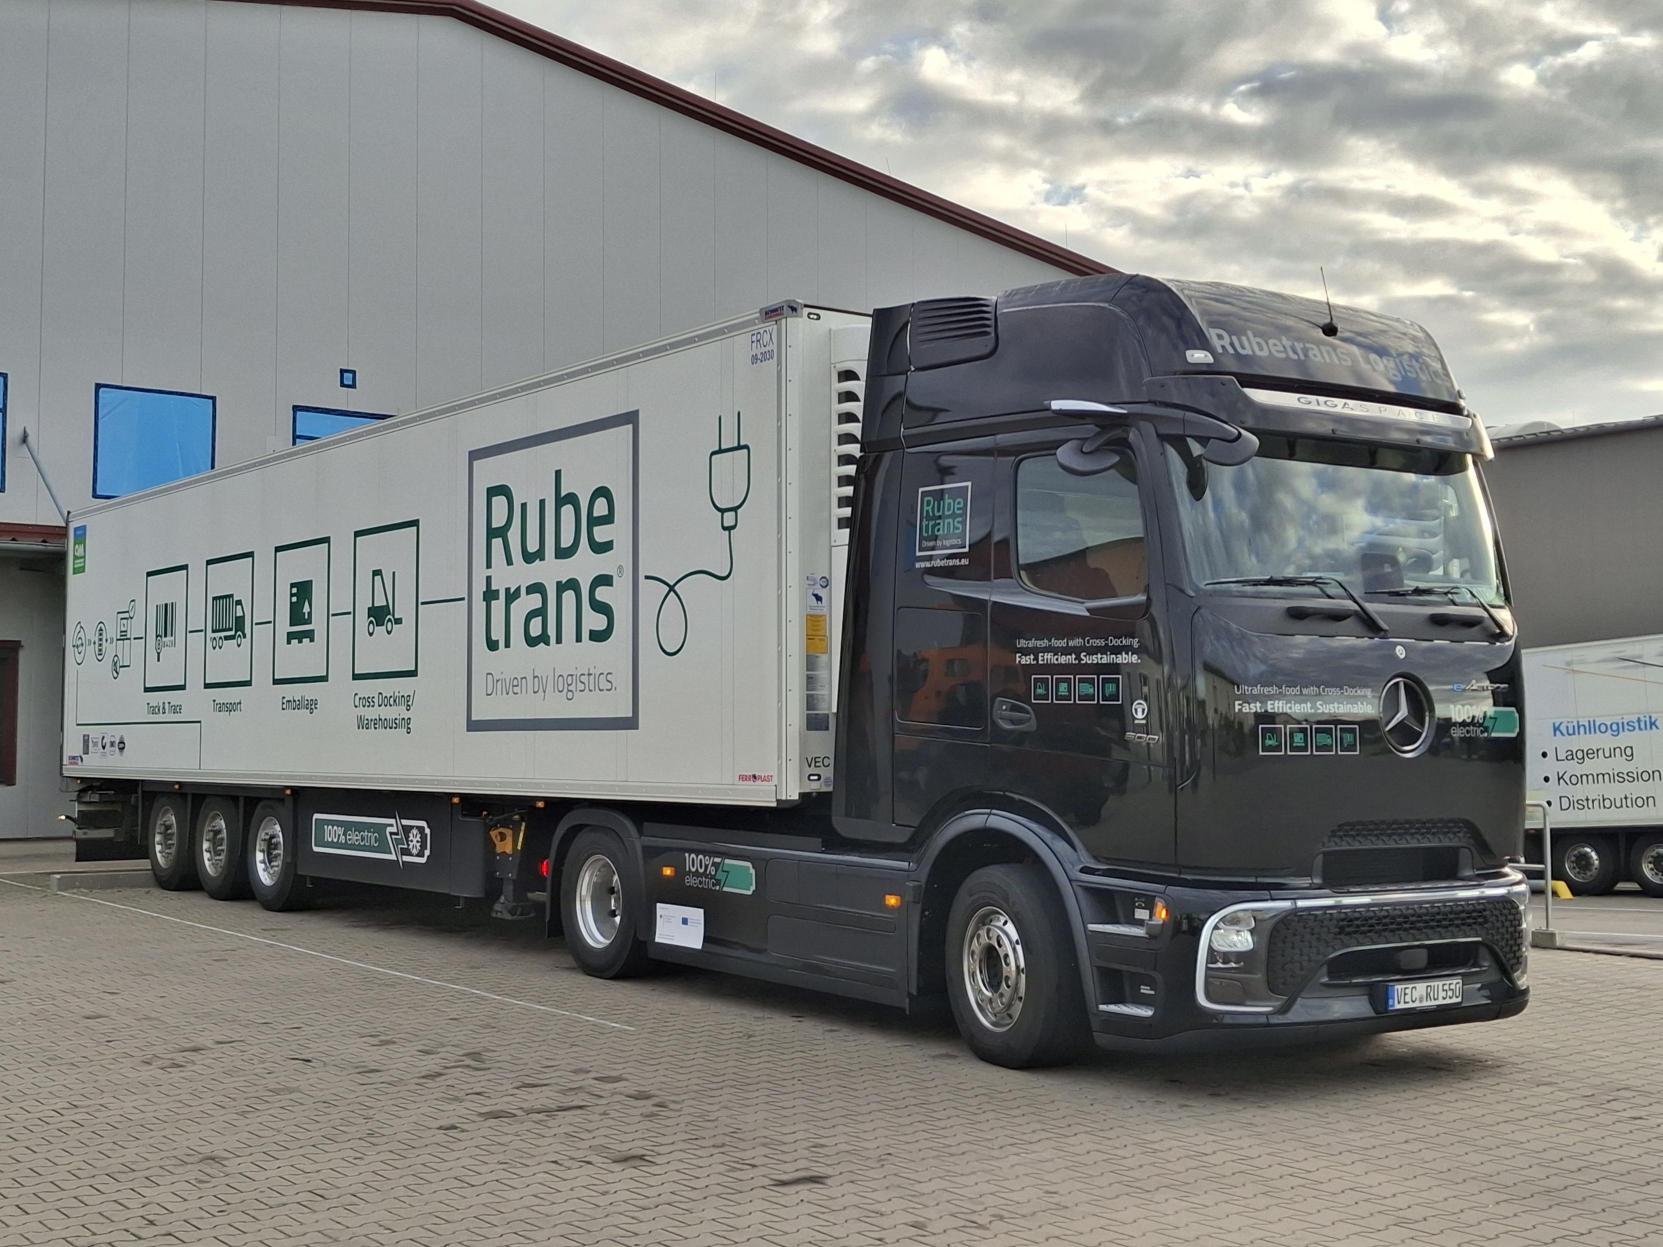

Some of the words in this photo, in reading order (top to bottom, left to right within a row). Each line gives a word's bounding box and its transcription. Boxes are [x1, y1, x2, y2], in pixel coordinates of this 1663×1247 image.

[750, 328, 775, 352] FRCX
[1208, 327, 1354, 368] Rubetrans
[750, 349, 775, 365] 09-2030
[923, 494, 964, 517] Rube
[485, 468, 616, 570] Rube
[922, 517, 963, 536] trans
[915, 558, 969, 569] www.rubetrans.eu
[1016, 637, 1067, 648] Ultrafresh-food
[1068, 637, 1084, 647] with
[1085, 636, 1141, 648] Cross-Docking.
[1015, 653, 1037, 665] Fast.
[1038, 653, 1079, 665] Efficient.
[1080, 652, 1141, 665] Sustainable.
[485, 671, 528, 697] Driven
[532, 667, 549, 701] by
[552, 665, 617, 701] logistics.
[1234, 685, 1300, 695] Ultrafresh-food
[1302, 685, 1319, 696] with
[146, 702, 161, 715] Track
[162, 702, 167, 714] &
[167, 701, 182, 714] Trace
[212, 699, 242, 716] Transport
[281, 695, 319, 715] Emballage
[353, 692, 376, 709] Cross
[377, 690, 416, 712] Docking/
[1234, 701, 1265, 713] Fast.
[1267, 700, 1315, 713] Efficient.
[1316, 702, 1375, 714] Sustainable.
[1449, 704, 1484, 723] 100%
[356, 713, 412, 735] Warehousing
[1552, 715, 1660, 738] Kühllogistik
[805, 756, 831, 768] VEC
[1554, 745, 1635, 765] Lagerung
[1556, 766, 1662, 786] Kommission
[1559, 793, 1657, 812] Distribution
[324, 824, 346, 844] 100%
[346, 827, 379, 847] electric
[684, 852, 716, 876] 100%
[684, 874, 720, 891] electric.
[1396, 986, 1418, 1005] VEC
[1425, 983, 1440, 1003] RU
[1441, 981, 1461, 1000] 550
